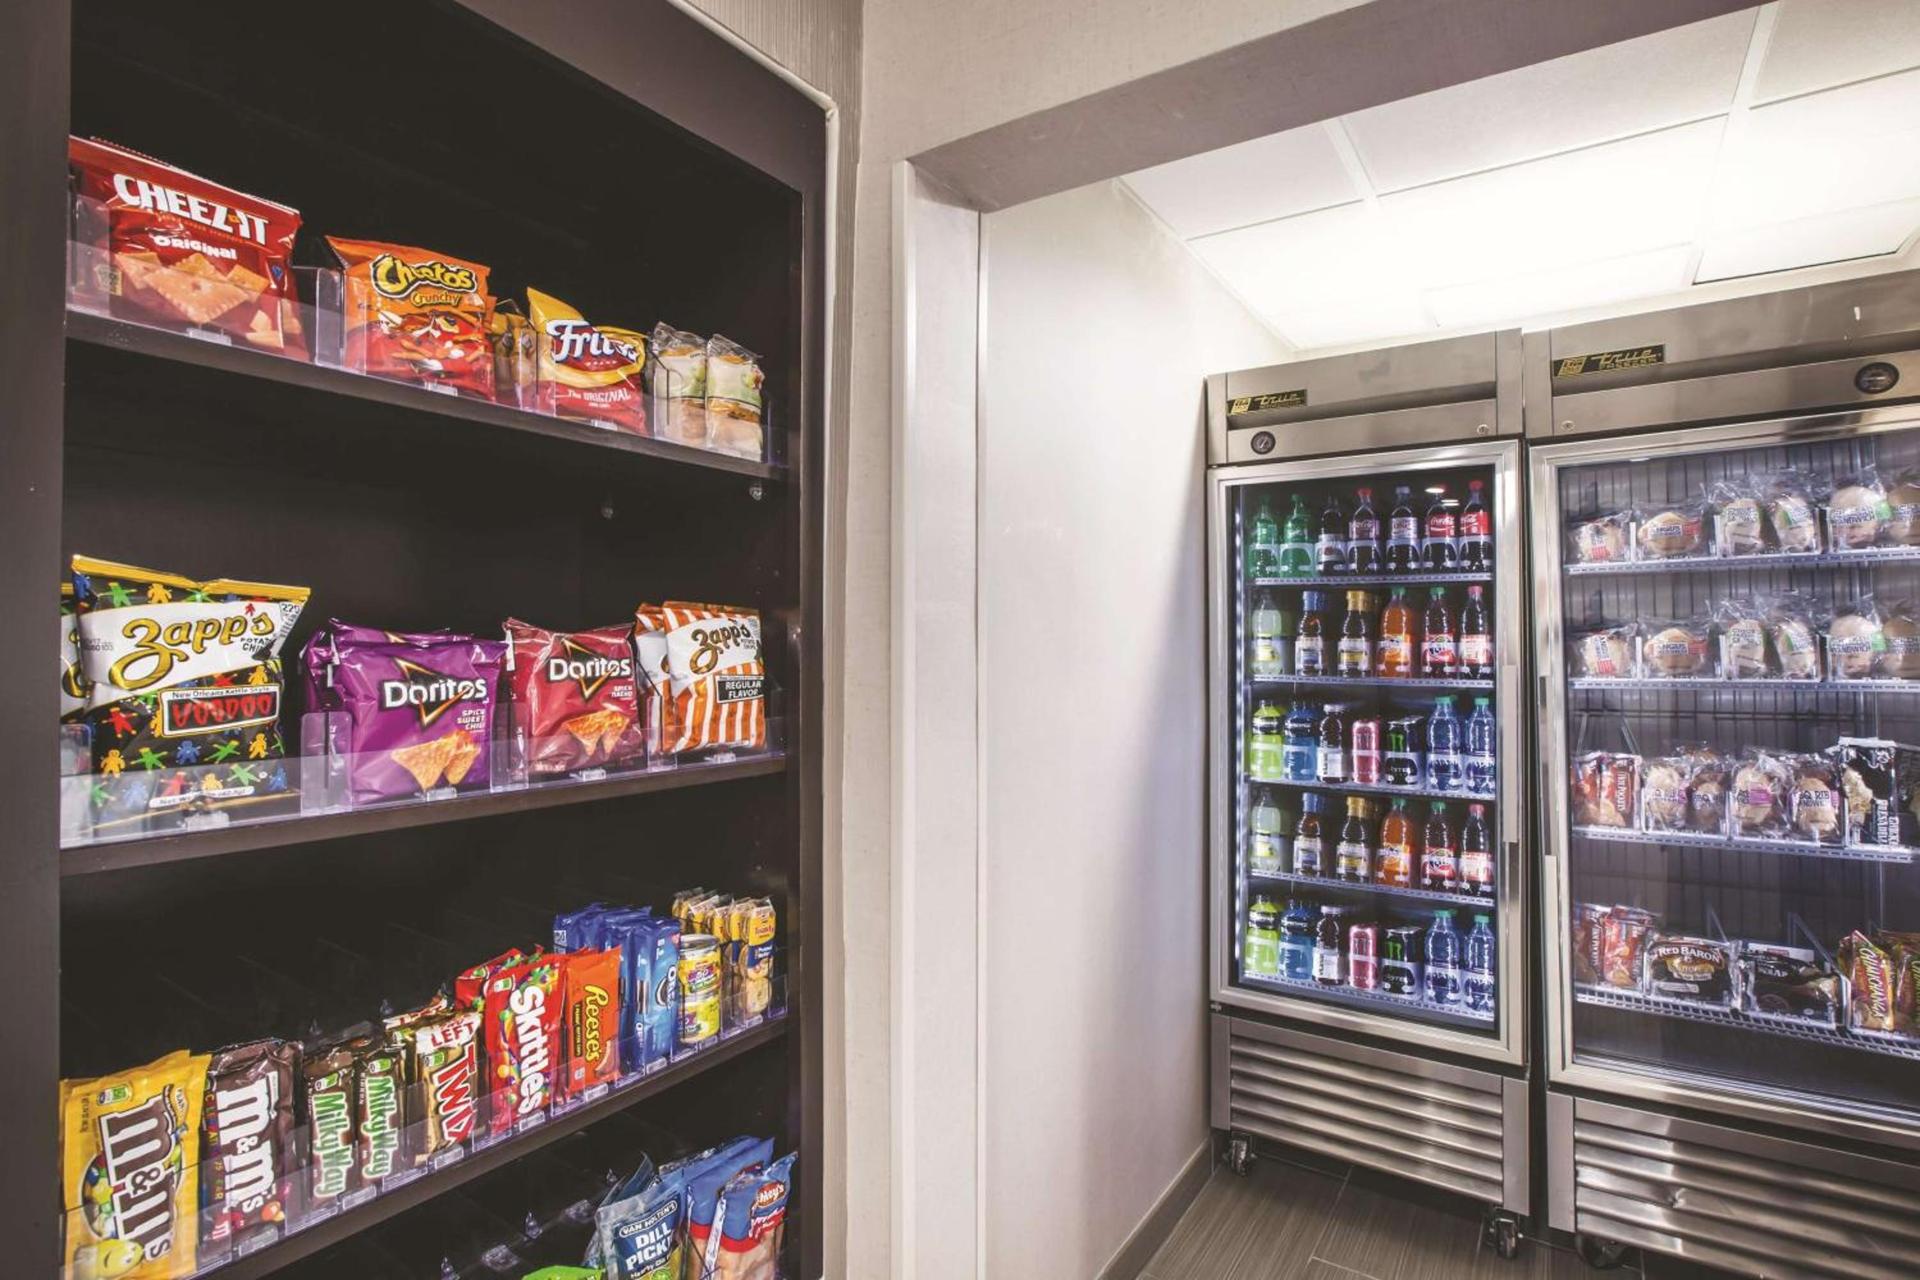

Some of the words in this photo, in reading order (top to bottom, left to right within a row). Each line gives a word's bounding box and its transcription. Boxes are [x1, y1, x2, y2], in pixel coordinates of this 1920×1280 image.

[373, 254, 475, 295] Cheetos
[549, 658, 632, 681] Doritos
[384, 678, 488, 708] Doritos
[725, 680, 762, 690] REGULAR
[728, 689, 759, 699] FLAVOR
[172, 694, 272, 729] VOODOO
[1681, 946, 1720, 963] BARON
[431, 1021, 475, 1047] LEFT
[584, 984, 609, 1062] Reese's
[509, 985, 550, 1114] Skittles
[432, 1042, 478, 1146] TWIX
[635, 1221, 672, 1249] DILL
